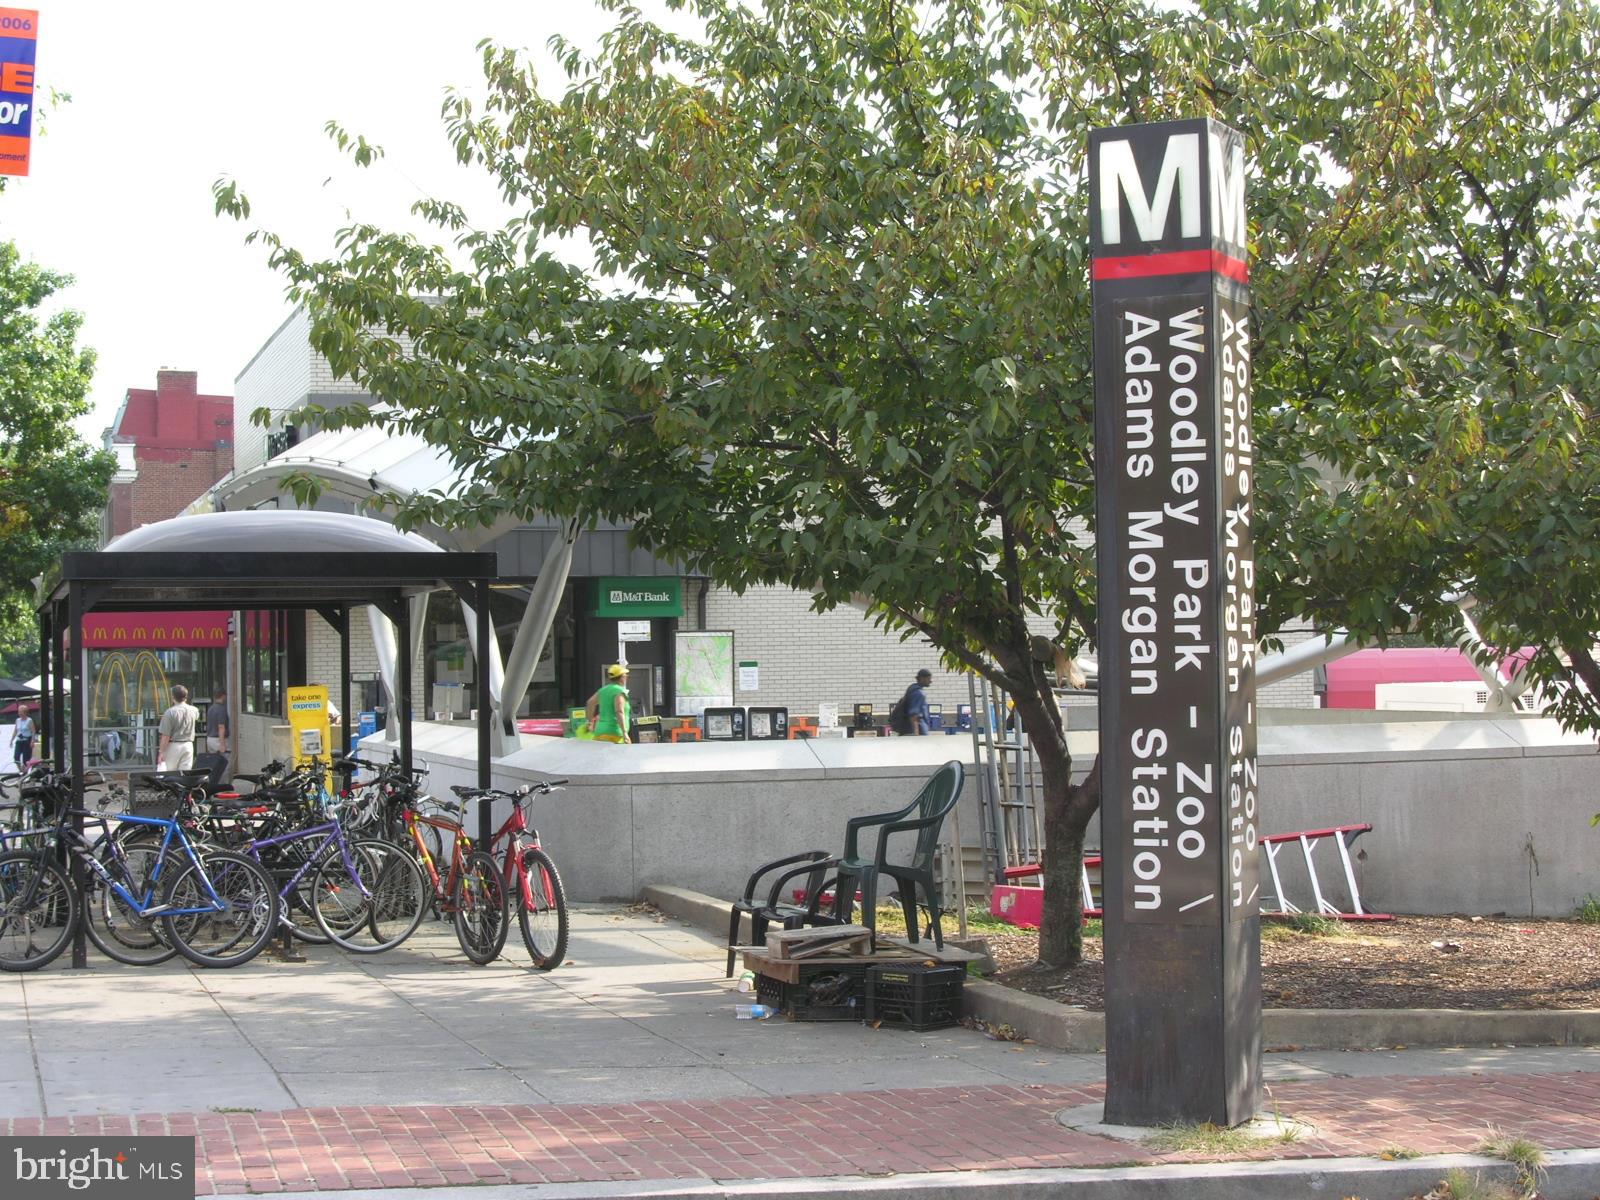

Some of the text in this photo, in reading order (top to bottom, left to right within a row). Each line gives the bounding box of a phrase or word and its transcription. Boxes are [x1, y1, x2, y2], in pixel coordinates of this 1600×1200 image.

[0, 17, 32, 31] 006
[0, 62, 34, 94] E
[1099, 133, 1201, 245] M
[1209, 132, 1245, 249] M
[1163, 305, 1207, 526] Woodley
[1235, 316, 1252, 528] Woodley
[623, 591, 670, 602] M&T Bank
[1121, 311, 1169, 912] Adams Morgan Station
[1173, 559, 1210, 672] Park
[1220, 308, 1244, 908] Adams Morgan Station
[1240, 559, 1255, 669] Park
[291, 694, 306, 702] take
[292, 702, 321, 710] express
[1175, 761, 1213, 859] Zoo
[1243, 757, 1258, 852] Zoo
